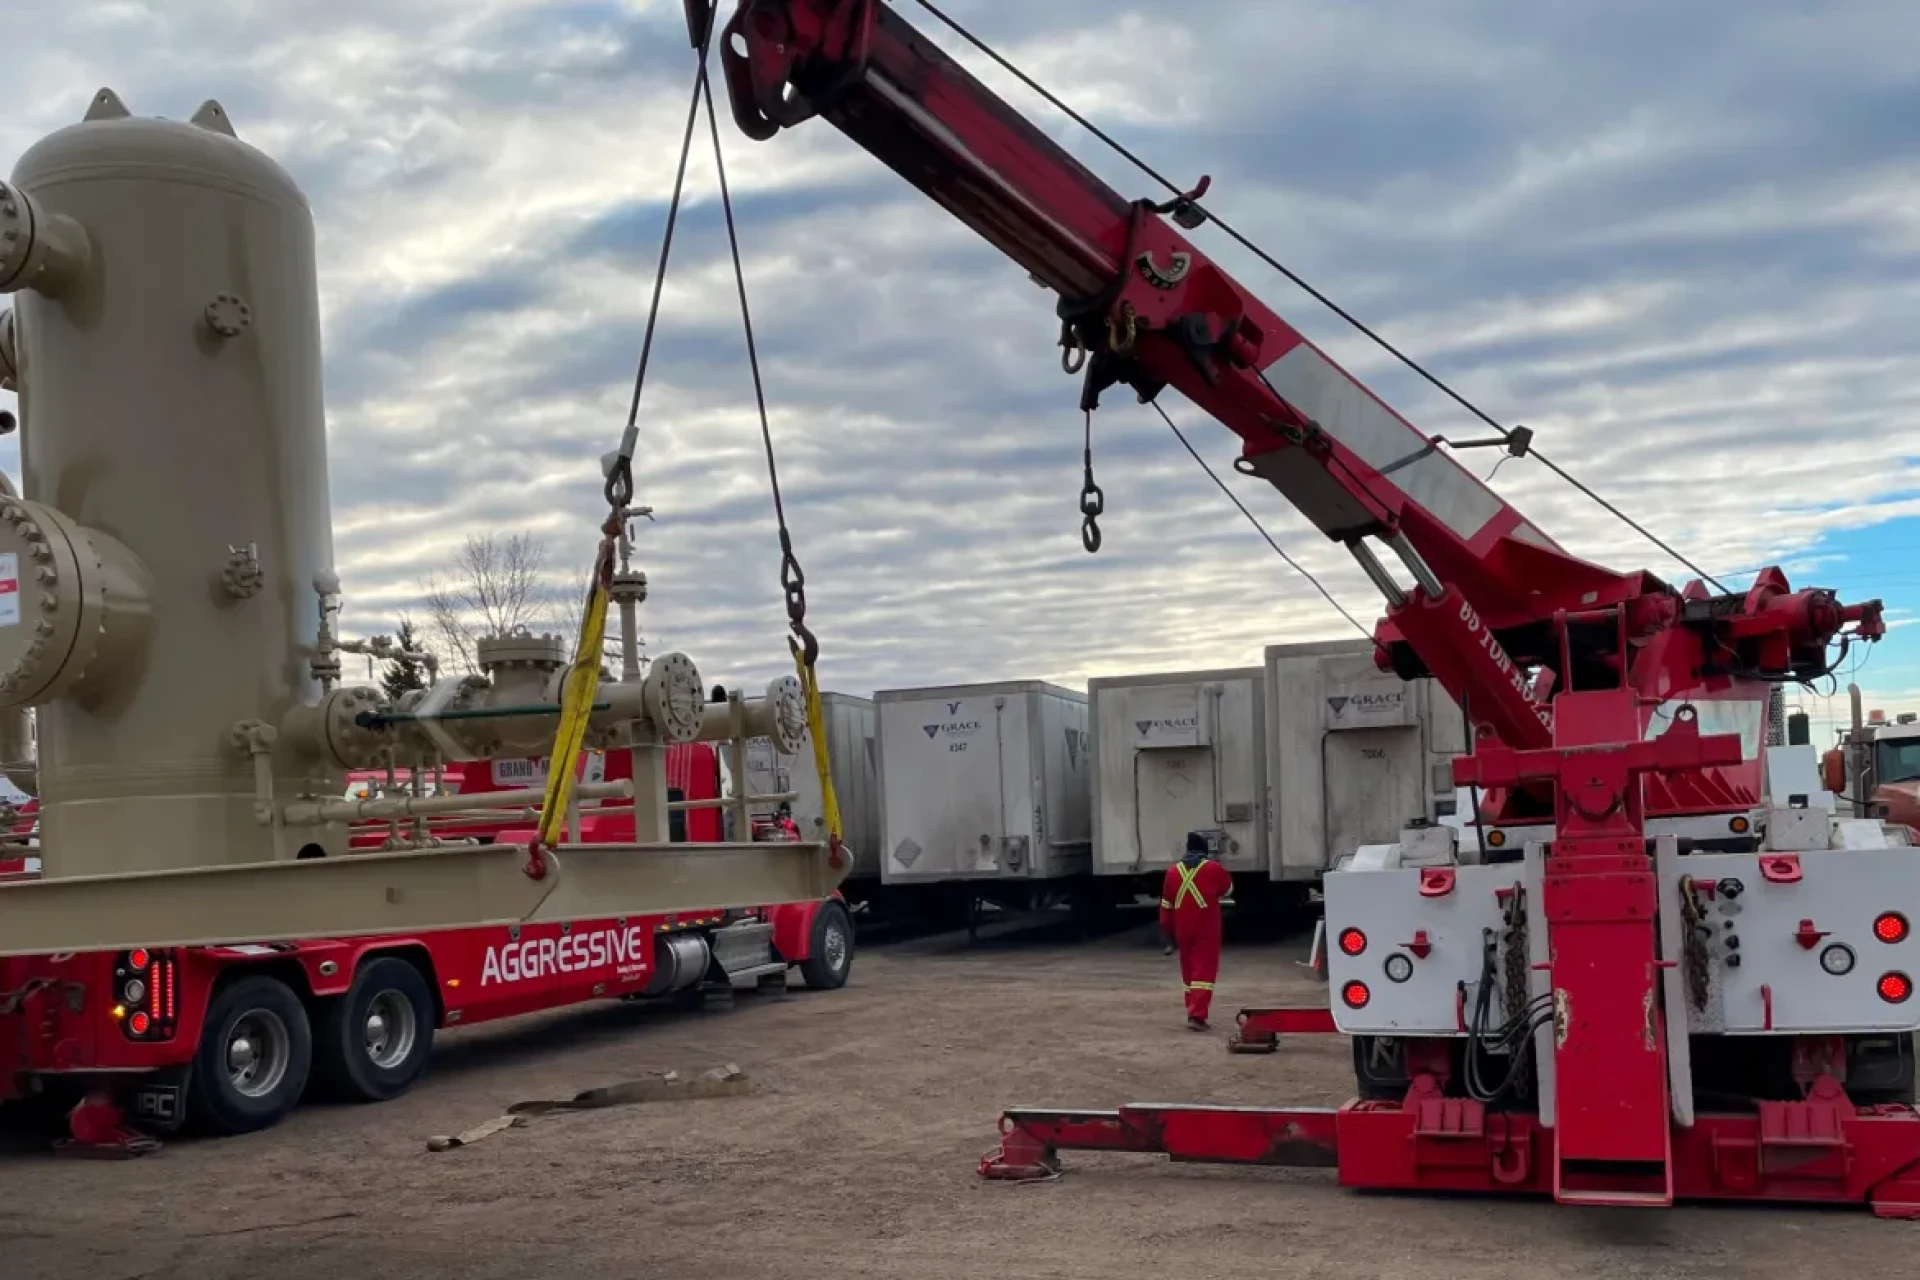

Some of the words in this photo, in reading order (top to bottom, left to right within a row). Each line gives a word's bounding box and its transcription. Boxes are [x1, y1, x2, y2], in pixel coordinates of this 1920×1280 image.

[1351, 692, 1406, 705] GRACE
[941, 720, 982, 733] GRACE
[1153, 718, 1198, 728] GRACE
[499, 761, 533, 778] GRAND
[480, 925, 641, 987] AGGRESSIVE
